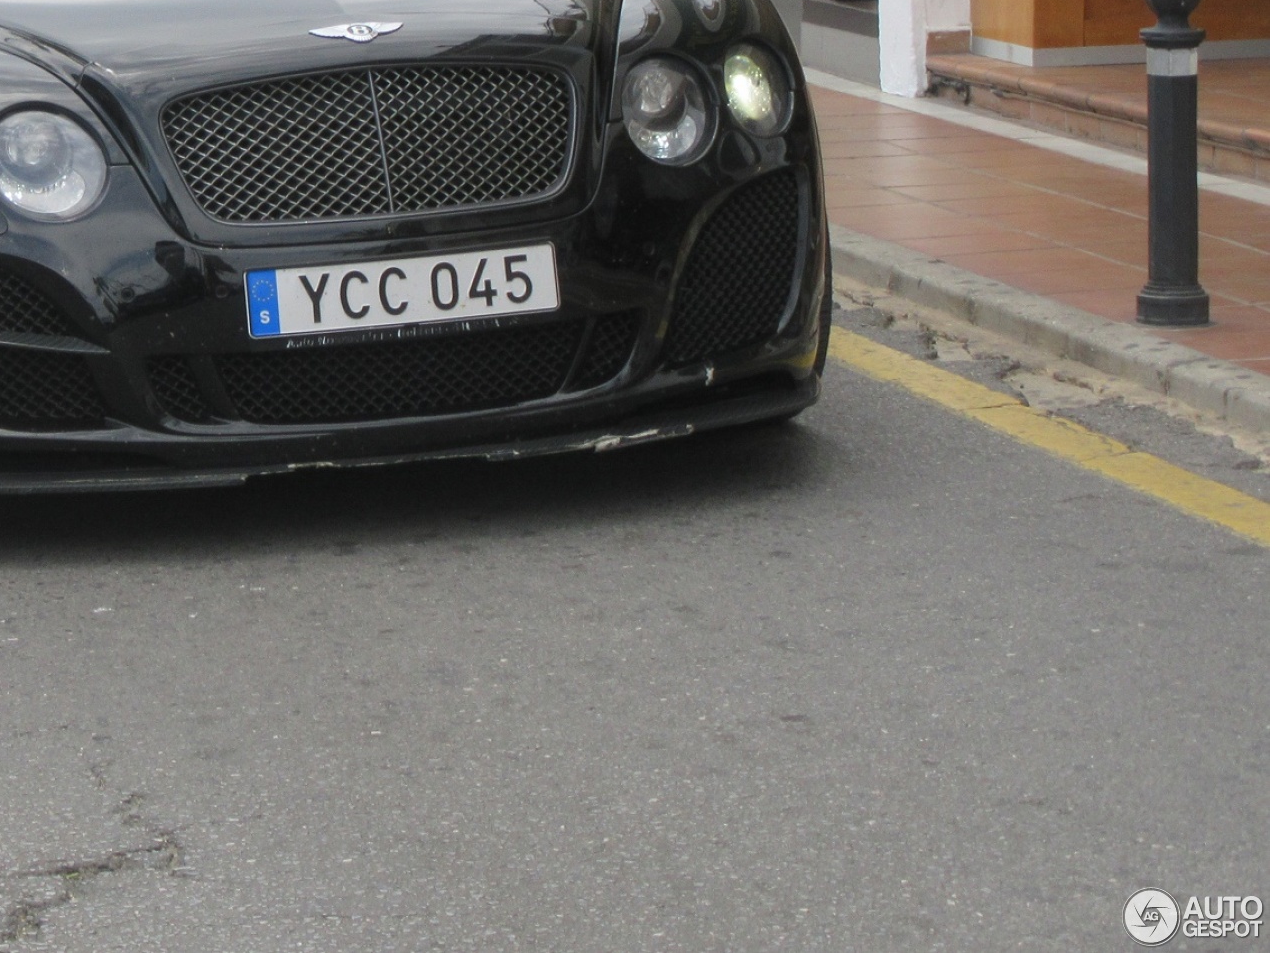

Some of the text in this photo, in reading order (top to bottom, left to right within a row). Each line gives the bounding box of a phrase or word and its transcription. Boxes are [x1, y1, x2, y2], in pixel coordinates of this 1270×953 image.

[298, 254, 533, 324] YCC 045
[259, 310, 270, 324] S
